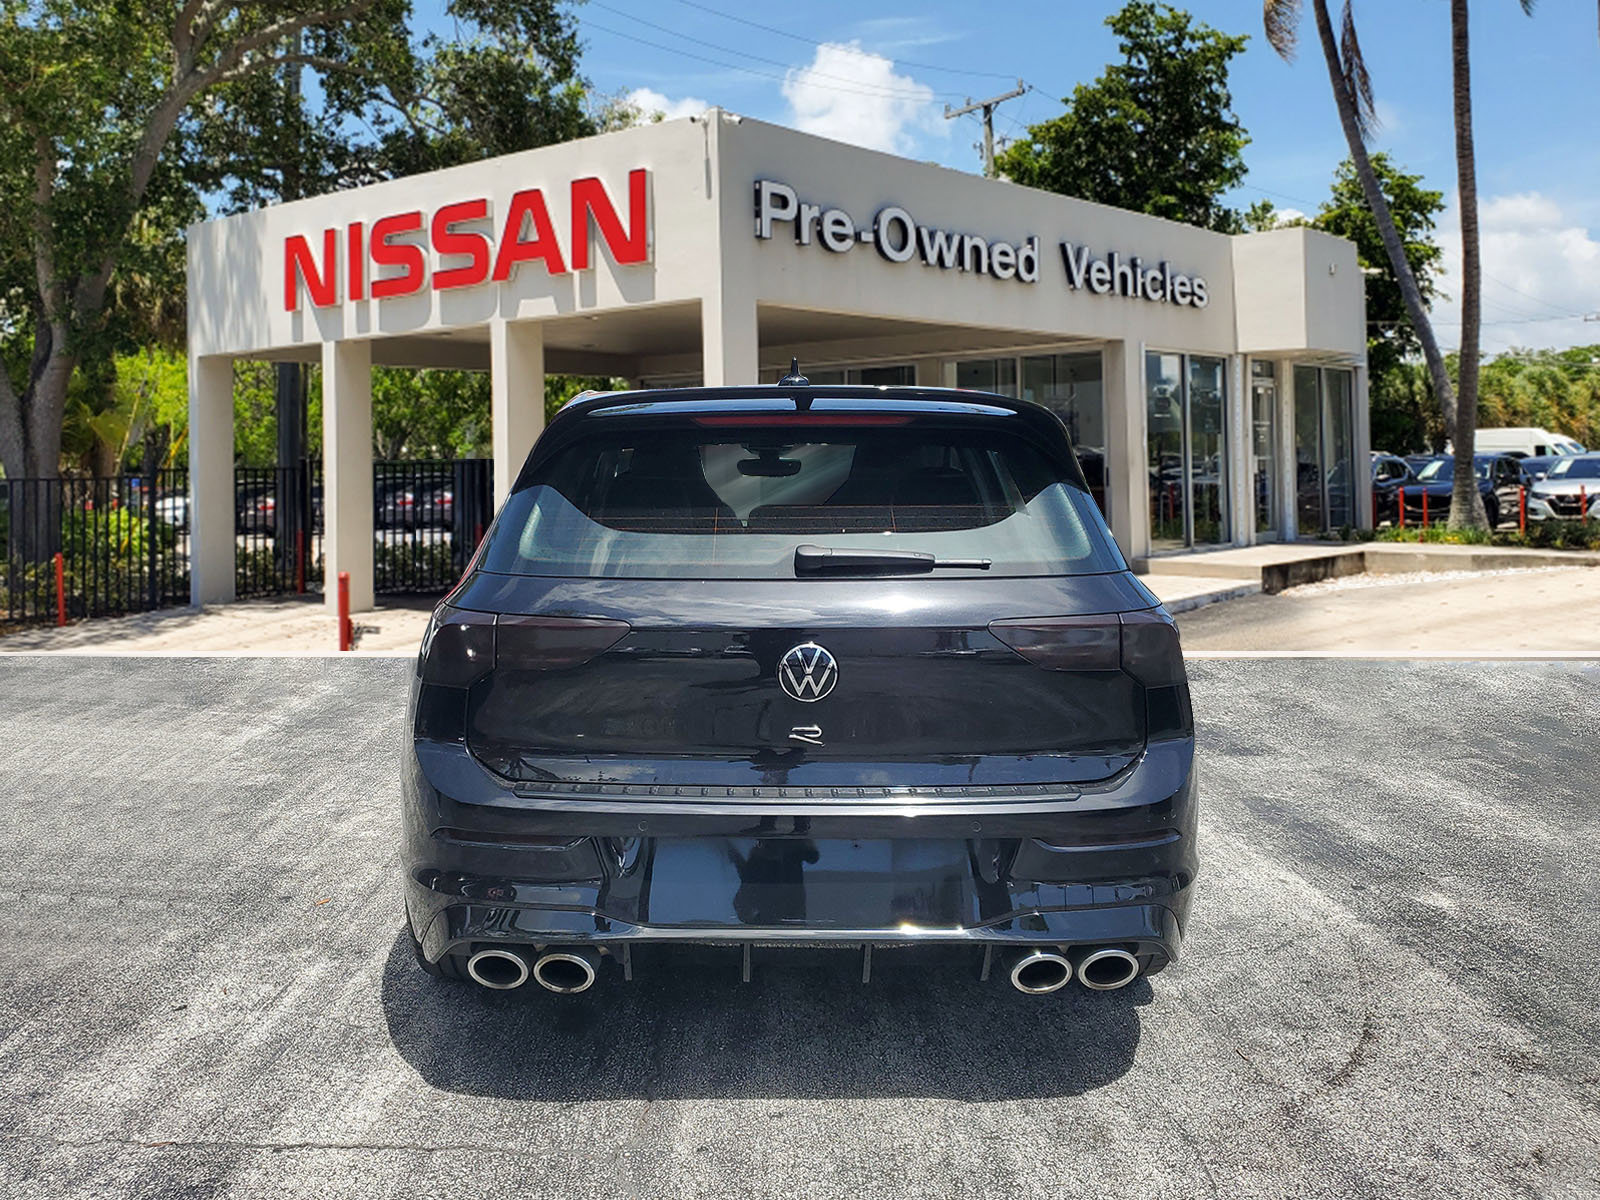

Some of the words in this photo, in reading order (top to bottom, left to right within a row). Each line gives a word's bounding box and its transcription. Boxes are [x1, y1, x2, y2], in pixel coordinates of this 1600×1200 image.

[284, 169, 648, 311] NISSAN
[755, 179, 1041, 283] Pre-Owned
[1059, 242, 1209, 309] Vehicles
